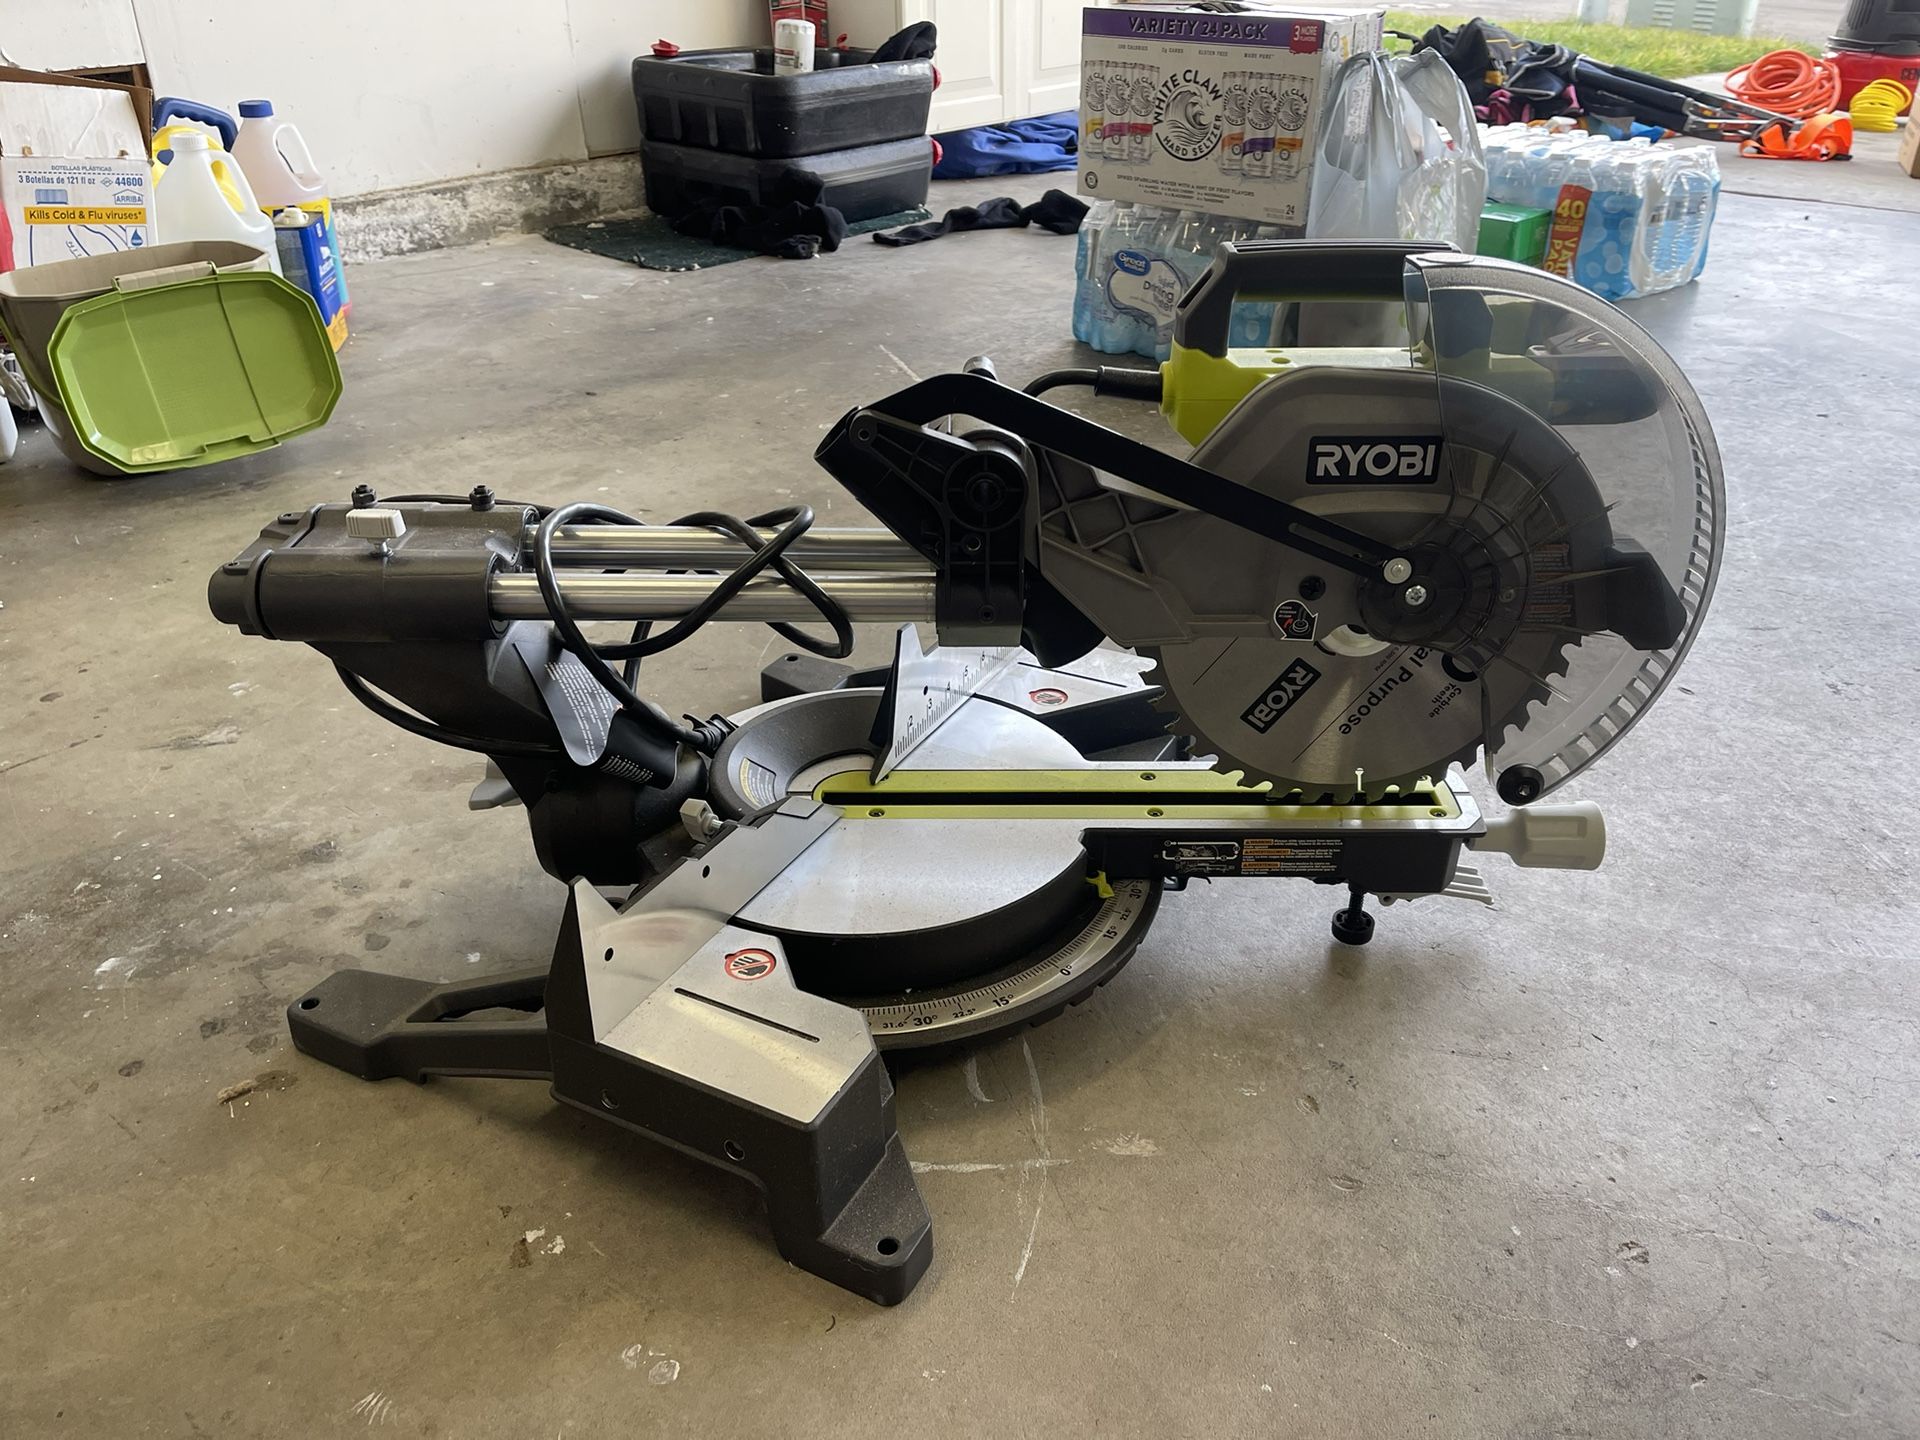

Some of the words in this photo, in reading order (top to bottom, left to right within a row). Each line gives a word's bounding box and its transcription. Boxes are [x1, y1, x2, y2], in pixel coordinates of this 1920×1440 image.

[1129, 16, 1199, 36] VARIETY
[1200, 20, 1218, 37] 24
[1220, 21, 1270, 40] PACK
[1293, 25, 1300, 41] 3
[1153, 73, 1180, 125] WHITE
[1183, 69, 1223, 101] CLAW
[1163, 136, 1188, 156] HARD
[1192, 115, 1222, 156] SELTZER
[18, 175, 24, 183] 3
[25, 175, 54, 184] Botellas
[56, 176, 65, 184] de
[67, 176, 79, 184] 121
[115, 177, 143, 186] 44600
[29, 210, 50, 219] Kills
[53, 210, 75, 219] Cold
[79, 211, 86, 219] &
[88, 210, 103, 219] Flu
[1286, 205, 1295, 215] 24
[1556, 199, 1585, 219] 40
[1315, 444, 1436, 476] RYOBI
[1409, 647, 1432, 668] al
[1248, 665, 1315, 728] RYOBI
[1339, 666, 1414, 735] Purpose
[1431, 682, 1457, 704] Teeth
[927, 698, 933, 710] 3
[1429, 687, 1463, 718] Carbide
[908, 715, 914, 726] 2
[1060, 964, 1073, 977] 0°
[992, 993, 1015, 1008] 15°
[913, 1014, 938, 1027] 30°
[953, 1008, 976, 1019] 22.5°
